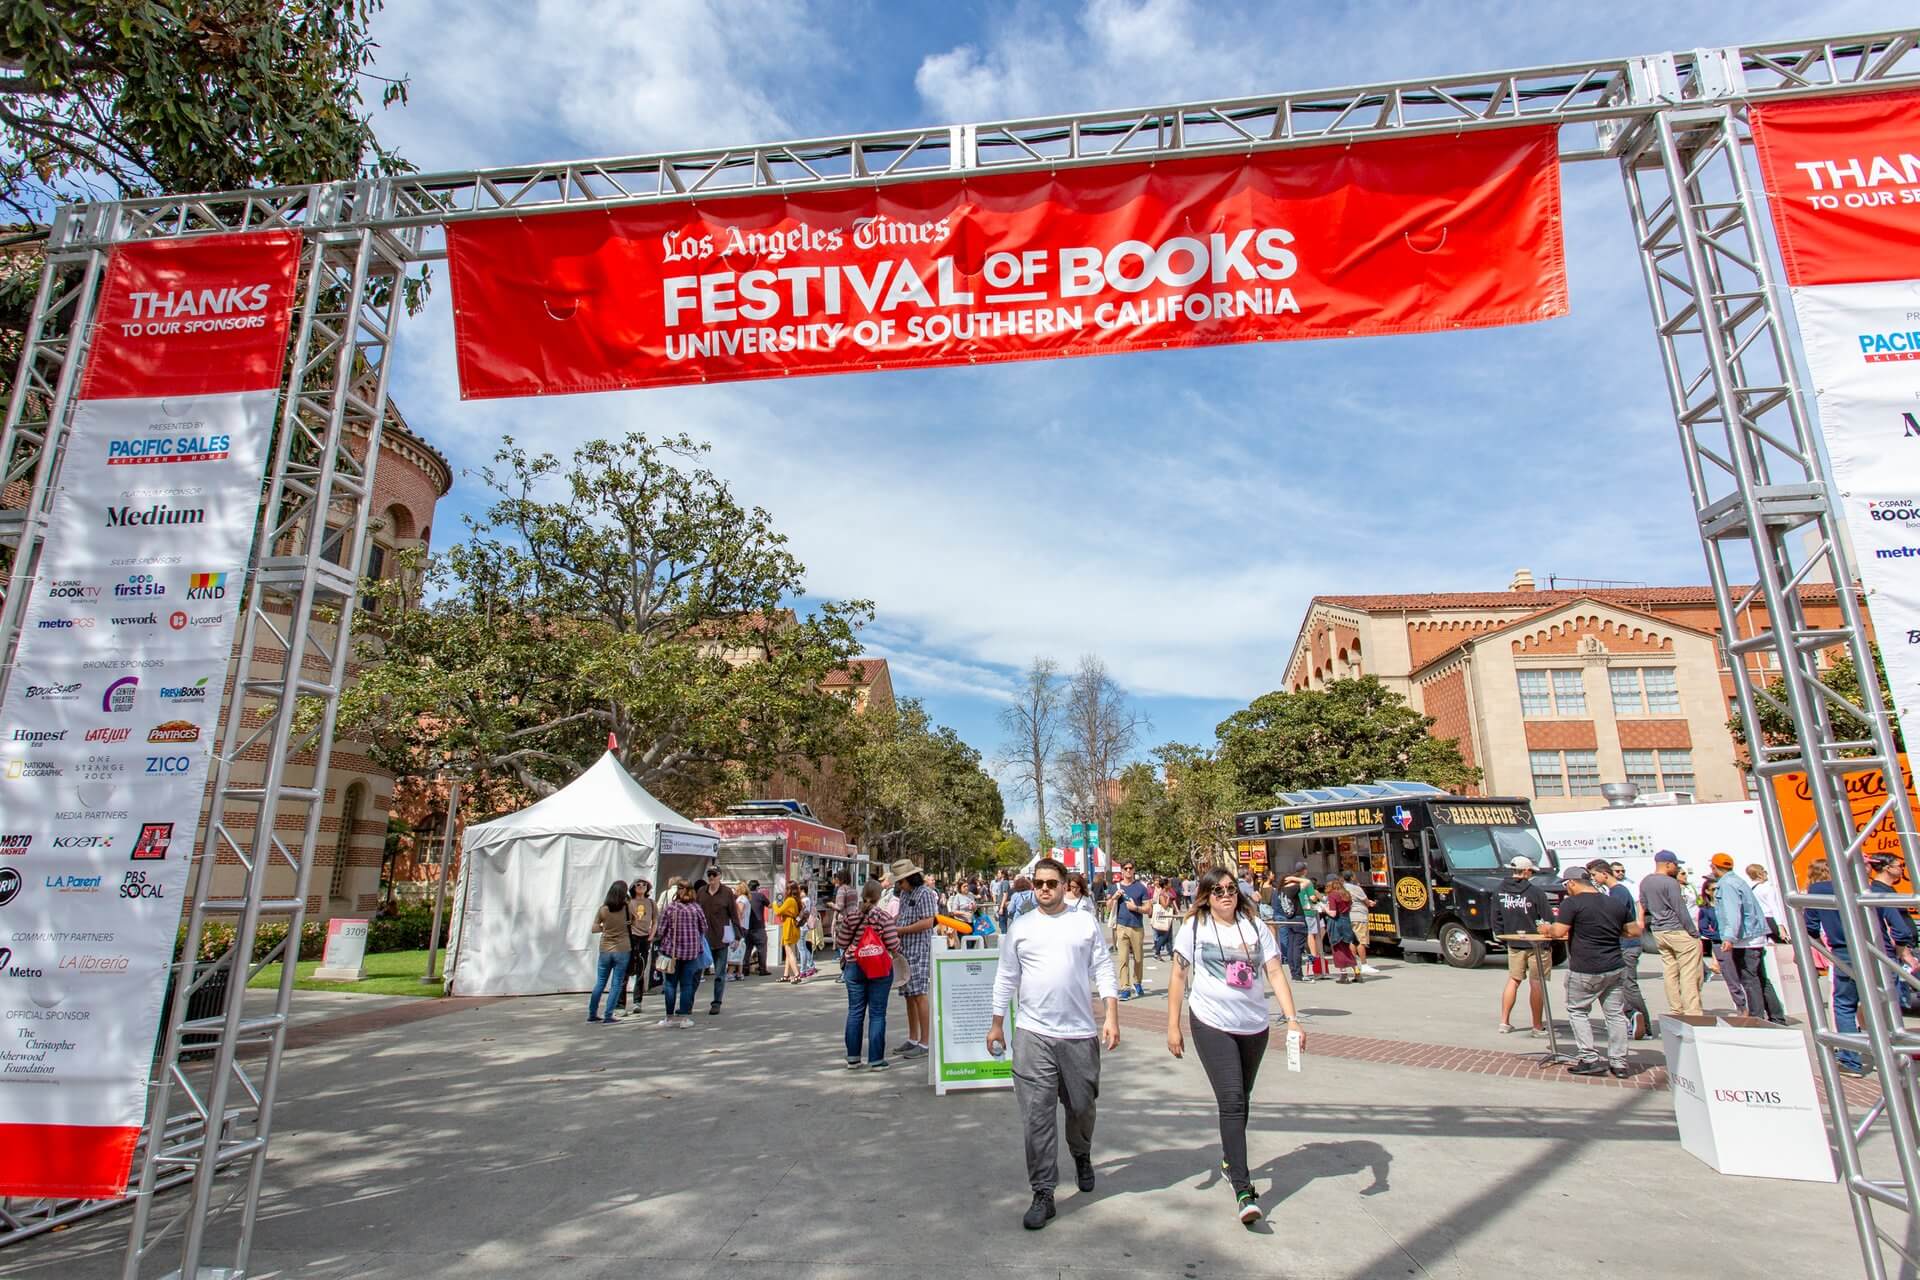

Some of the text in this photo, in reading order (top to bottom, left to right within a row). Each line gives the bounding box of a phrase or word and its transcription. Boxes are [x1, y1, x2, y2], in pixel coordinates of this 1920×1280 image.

[1807, 195, 1839, 211] TO
[1844, 192, 1896, 209] OUR
[662, 214, 950, 263] Los Angeles Times
[663, 228, 1298, 327] FESTIVAL OF BOOKS
[129, 283, 271, 319] THANKS
[121, 314, 267, 337] TO OUR SPONSORS
[666, 287, 1300, 361] UNIVERSITY OF SOUTHERN CALIFORNIA
[149, 421, 205, 431] PRESENTED BY
[109, 435, 230, 457] PACIFIC SALES
[106, 505, 205, 527] Medium
[138, 556, 182, 565] SPONSORS
[187, 586, 225, 600] KIND
[38, 618, 95, 629] metroPCS
[111, 611, 158, 625] wework
[190, 614, 222, 626] Lycored
[83, 660, 165, 669] BRONZE SPONSORS
[116, 687, 136, 695] CENTER
[13, 730, 66, 741] Honest
[150, 728, 197, 740] PANTAGES
[146, 756, 190, 772] ZICO
[23, 769, 63, 777] GEOGRAPHIC
[55, 811, 128, 820] MEDIA PARTNERS
[1313, 809, 1357, 827] BARBECUE
[1450, 806, 1517, 825] BARBECUE
[67, 875, 101, 887] Parent
[124, 872, 146, 884] PBS
[11, 933, 115, 942] COMMUNITY PARTNERS
[345, 927, 367, 936] 3709
[9, 967, 42, 978] Metro
[6, 1010, 90, 1020] OFFICIAL SPONSOR
[18, 1028, 35, 1038] The
[25, 1039, 76, 1052] Christopher
[4, 1063, 56, 1073] Foundation
[1715, 1089, 1781, 1104] USCFMS
